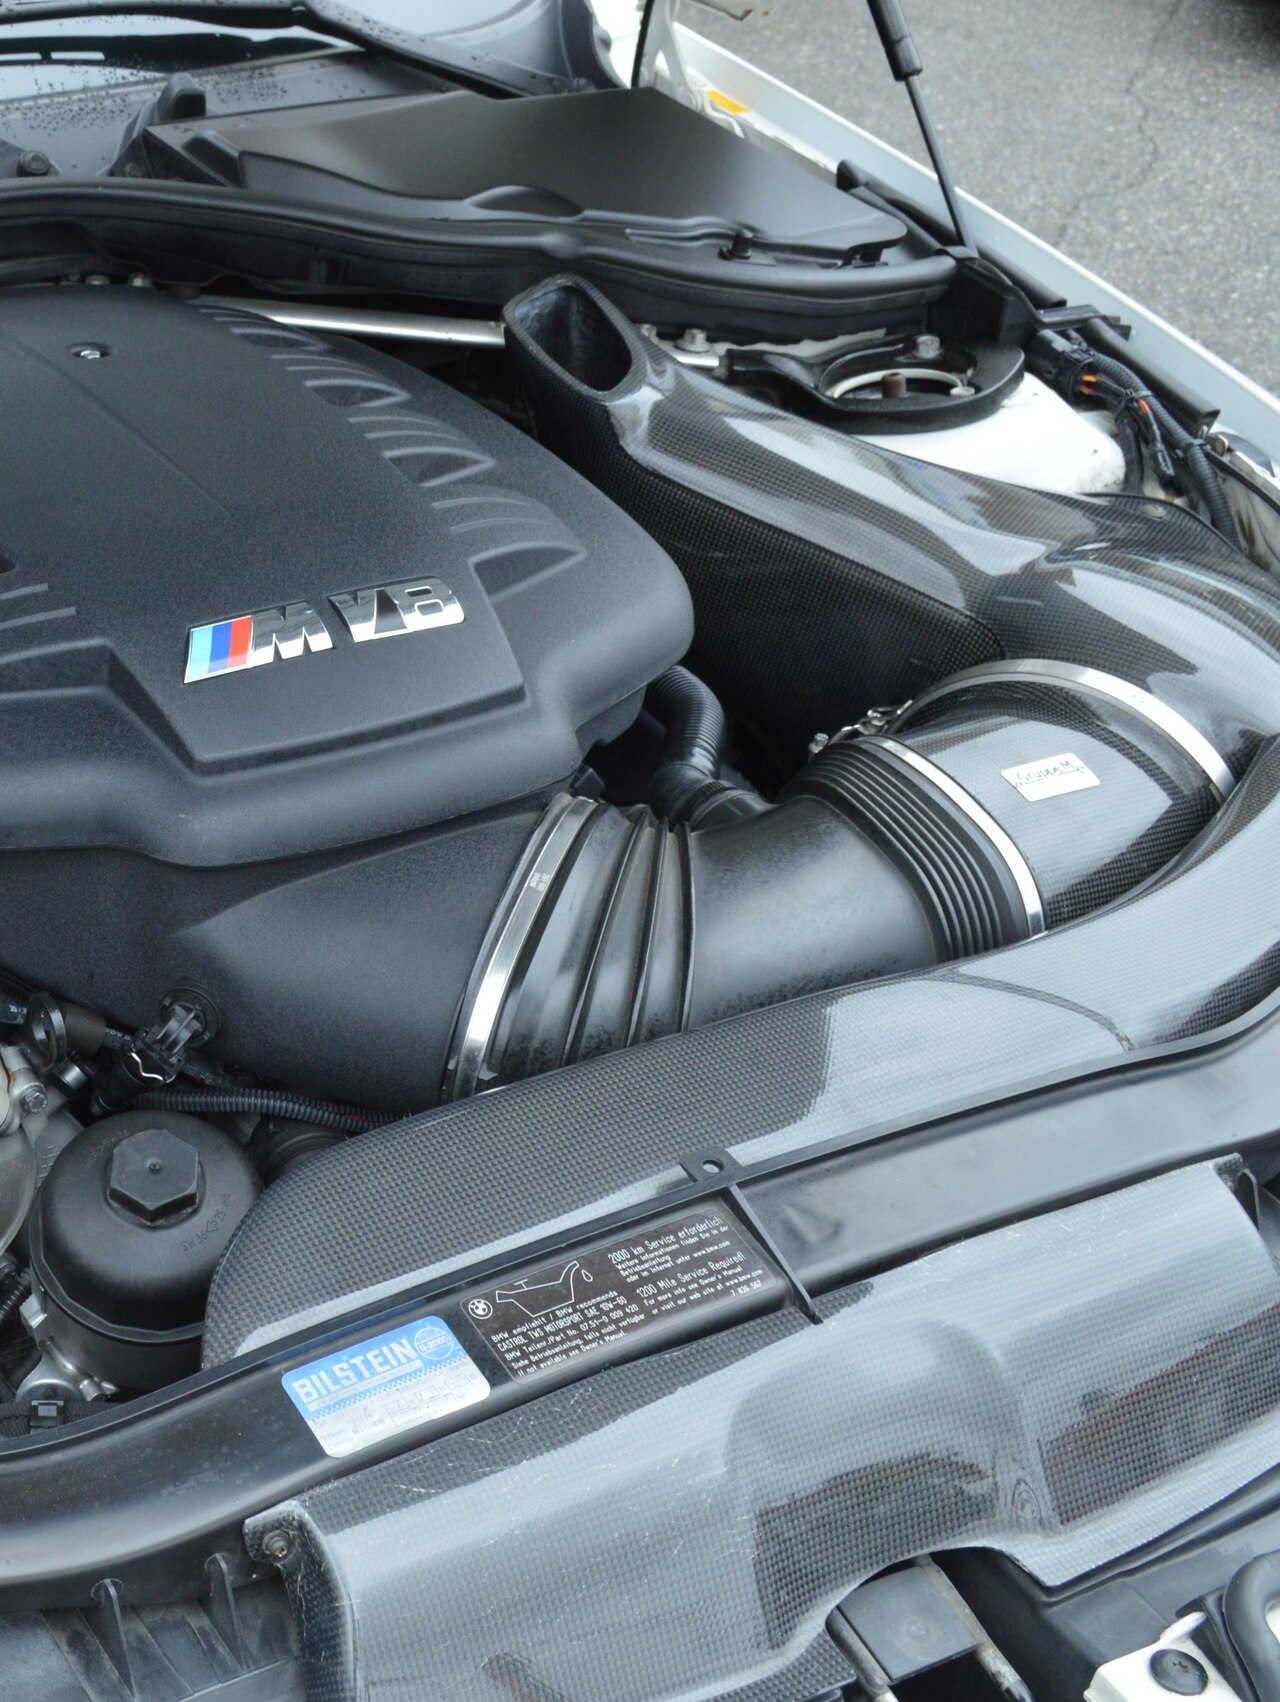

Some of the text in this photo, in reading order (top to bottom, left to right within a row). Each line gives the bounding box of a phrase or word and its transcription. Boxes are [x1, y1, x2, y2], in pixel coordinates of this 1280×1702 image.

[327, 576, 465, 643] V8
[608, 1249, 631, 1263] 2000
[644, 1232, 676, 1250] Service
[675, 1216, 724, 1239] erforderlich
[616, 1258, 639, 1270] Weitere
[640, 1243, 680, 1261] Informationen
[680, 1236, 699, 1246] finden
[699, 1231, 710, 1239] Sie
[719, 1224, 729, 1232] der
[625, 1273, 640, 1282] oder
[650, 1261, 674, 1273] Internet
[675, 1255, 691, 1264] unter
[693, 1241, 731, 1258] www.bmw.com
[620, 1254, 671, 1277] Betriebsanleitung
[635, 1251, 747, 1299] 1200 Mile Service Required!
[644, 1265, 743, 1306] For more info see Owner's Manual
[750, 1279, 763, 1288] 567
[660, 1302, 676, 1311] visit
[676, 1296, 688, 1305] our
[688, 1291, 702, 1300] web
[702, 1286, 715, 1295] site
[724, 1269, 763, 1286] www.bmw.com
[491, 1331, 510, 1342] BMW
[511, 1317, 547, 1335] empfiehlt
[556, 1307, 574, 1318] BMW
[575, 1290, 619, 1310] recommends
[496, 1296, 628, 1351] CASTROL TWS MOTORSPORT SAE 10W-60
[504, 1349, 521, 1360] BMW
[566, 1326, 579, 1336] No.
[609, 1309, 624, 1320] 009
[625, 1303, 640, 1314] 420
[511, 1358, 530, 1369] Siehe
[584, 1331, 600, 1341] falls
[600, 1324, 617, 1335] nicht
[525, 1363, 538, 1373] not
[538, 1353, 567, 1368] available
[568, 1347, 580, 1357] see
[292, 1338, 417, 1404] BILSTEIN
